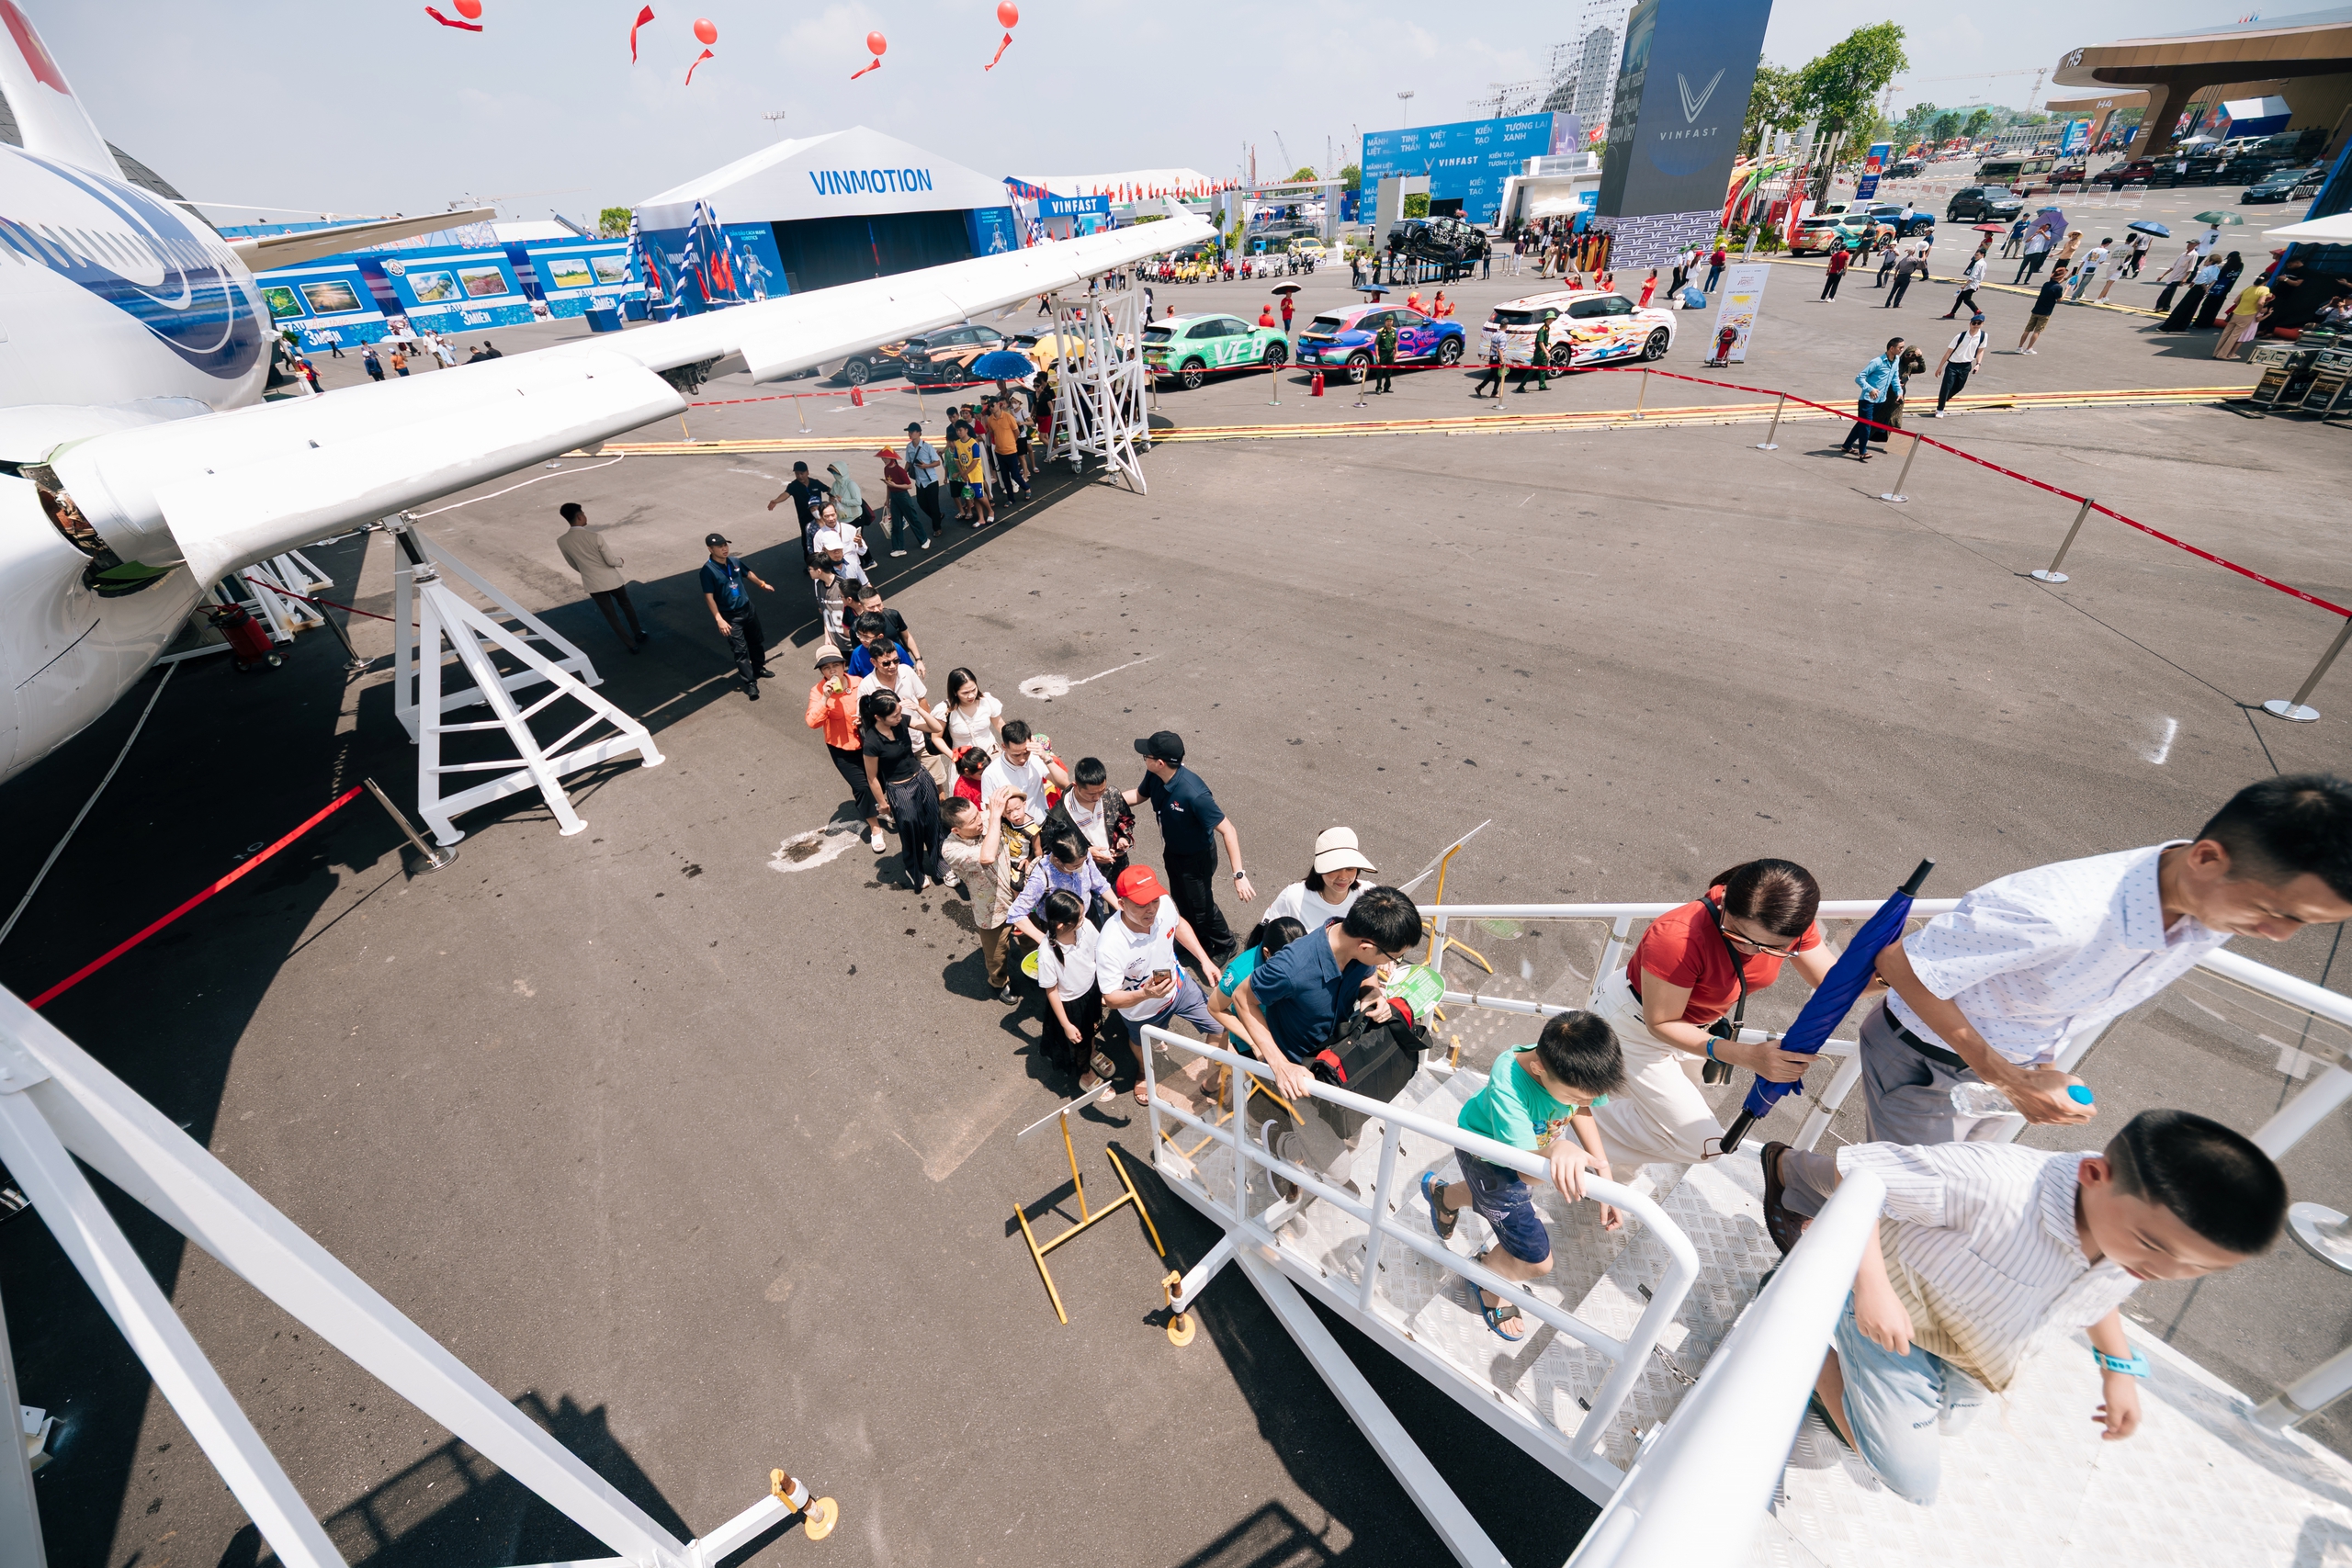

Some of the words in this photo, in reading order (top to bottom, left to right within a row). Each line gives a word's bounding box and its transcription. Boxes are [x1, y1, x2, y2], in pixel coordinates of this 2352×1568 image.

[2066, 49, 2084, 68] H5
[2097, 99, 2112, 109] H4
[1476, 124, 1493, 135] KIẾN
[1505, 121, 1532, 131] TƯƠNG
[1534, 120, 1548, 129] LAI
[1401, 135, 1419, 143] TINH
[1430, 130, 1446, 141] VIỆT
[1503, 132, 1526, 141] XANH
[1660, 127, 1717, 141] VINFAST
[1367, 137, 1388, 146] MÃNH
[1400, 141, 1420, 152] THẦN
[1475, 137, 1489, 146] TẠO
[1366, 147, 1381, 156] LIỆT
[1439, 156, 1478, 167] VINFAST
[808, 168, 933, 196] VINMOTION
[1051, 198, 1097, 214] VINFAST
